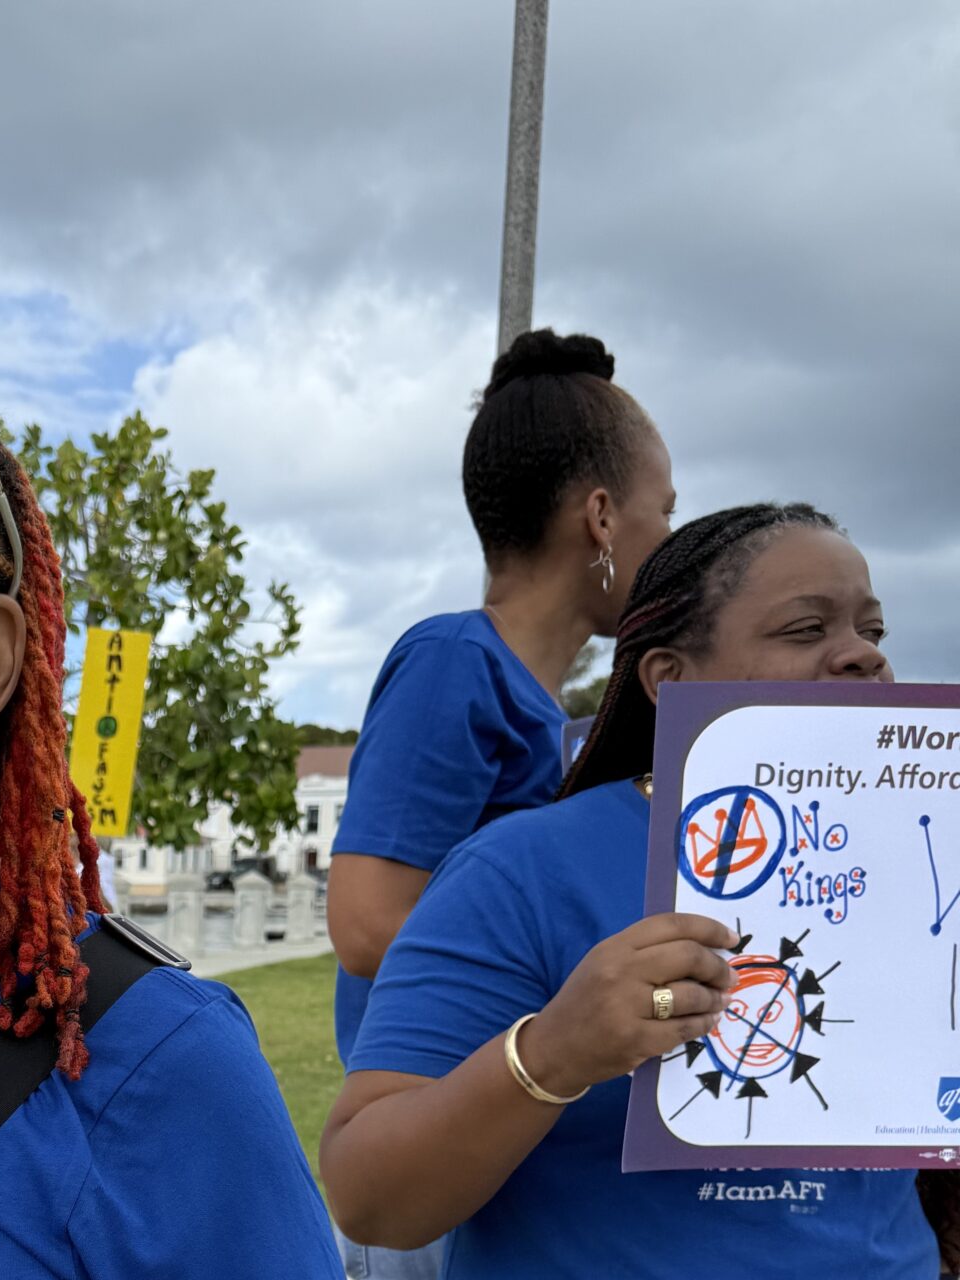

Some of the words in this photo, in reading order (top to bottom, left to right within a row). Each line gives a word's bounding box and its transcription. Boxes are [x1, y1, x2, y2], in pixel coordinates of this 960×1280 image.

[754, 762, 867, 795] Dignity.
[789, 800, 848, 857] No
[778, 861, 867, 924] Kings
[697, 1180, 826, 1201] #IamAFT
